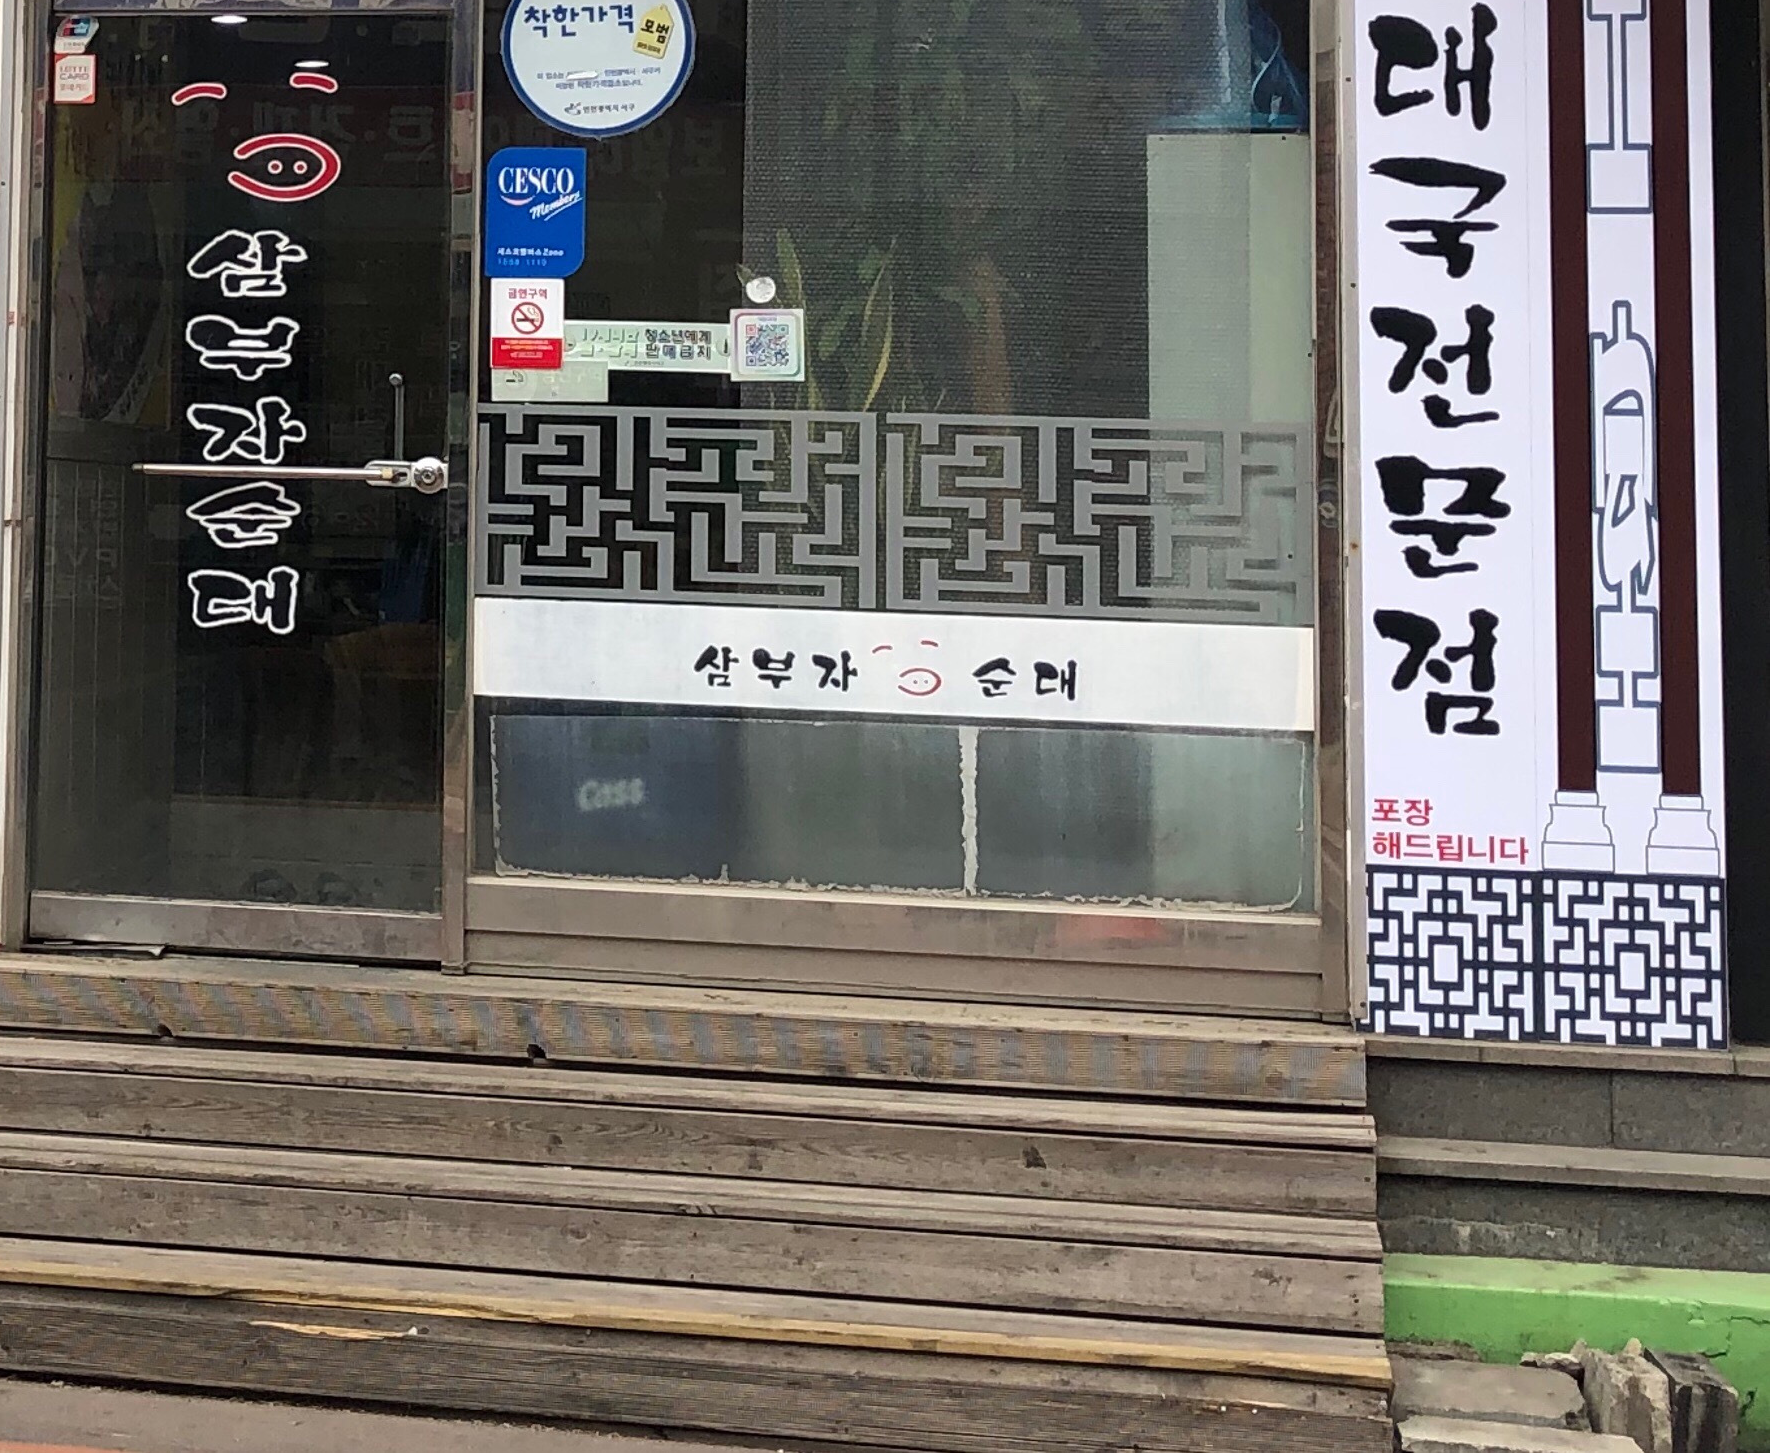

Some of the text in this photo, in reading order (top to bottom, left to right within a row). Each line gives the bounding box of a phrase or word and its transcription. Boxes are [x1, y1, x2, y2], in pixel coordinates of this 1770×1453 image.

[524, 4, 634, 38] 착한가격
[640, 18, 670, 44] 모범
[498, 167, 575, 194] CESCO
[645, 329, 712, 344] 청소년에게
[645, 344, 712, 360] 판매금지
[185, 229, 308, 635] 삼부자순대
[693, 645, 1079, 701] 삼부자 순대
[1371, 798, 1434, 826] 포장
[1371, 831, 1530, 865] 해드립니다
